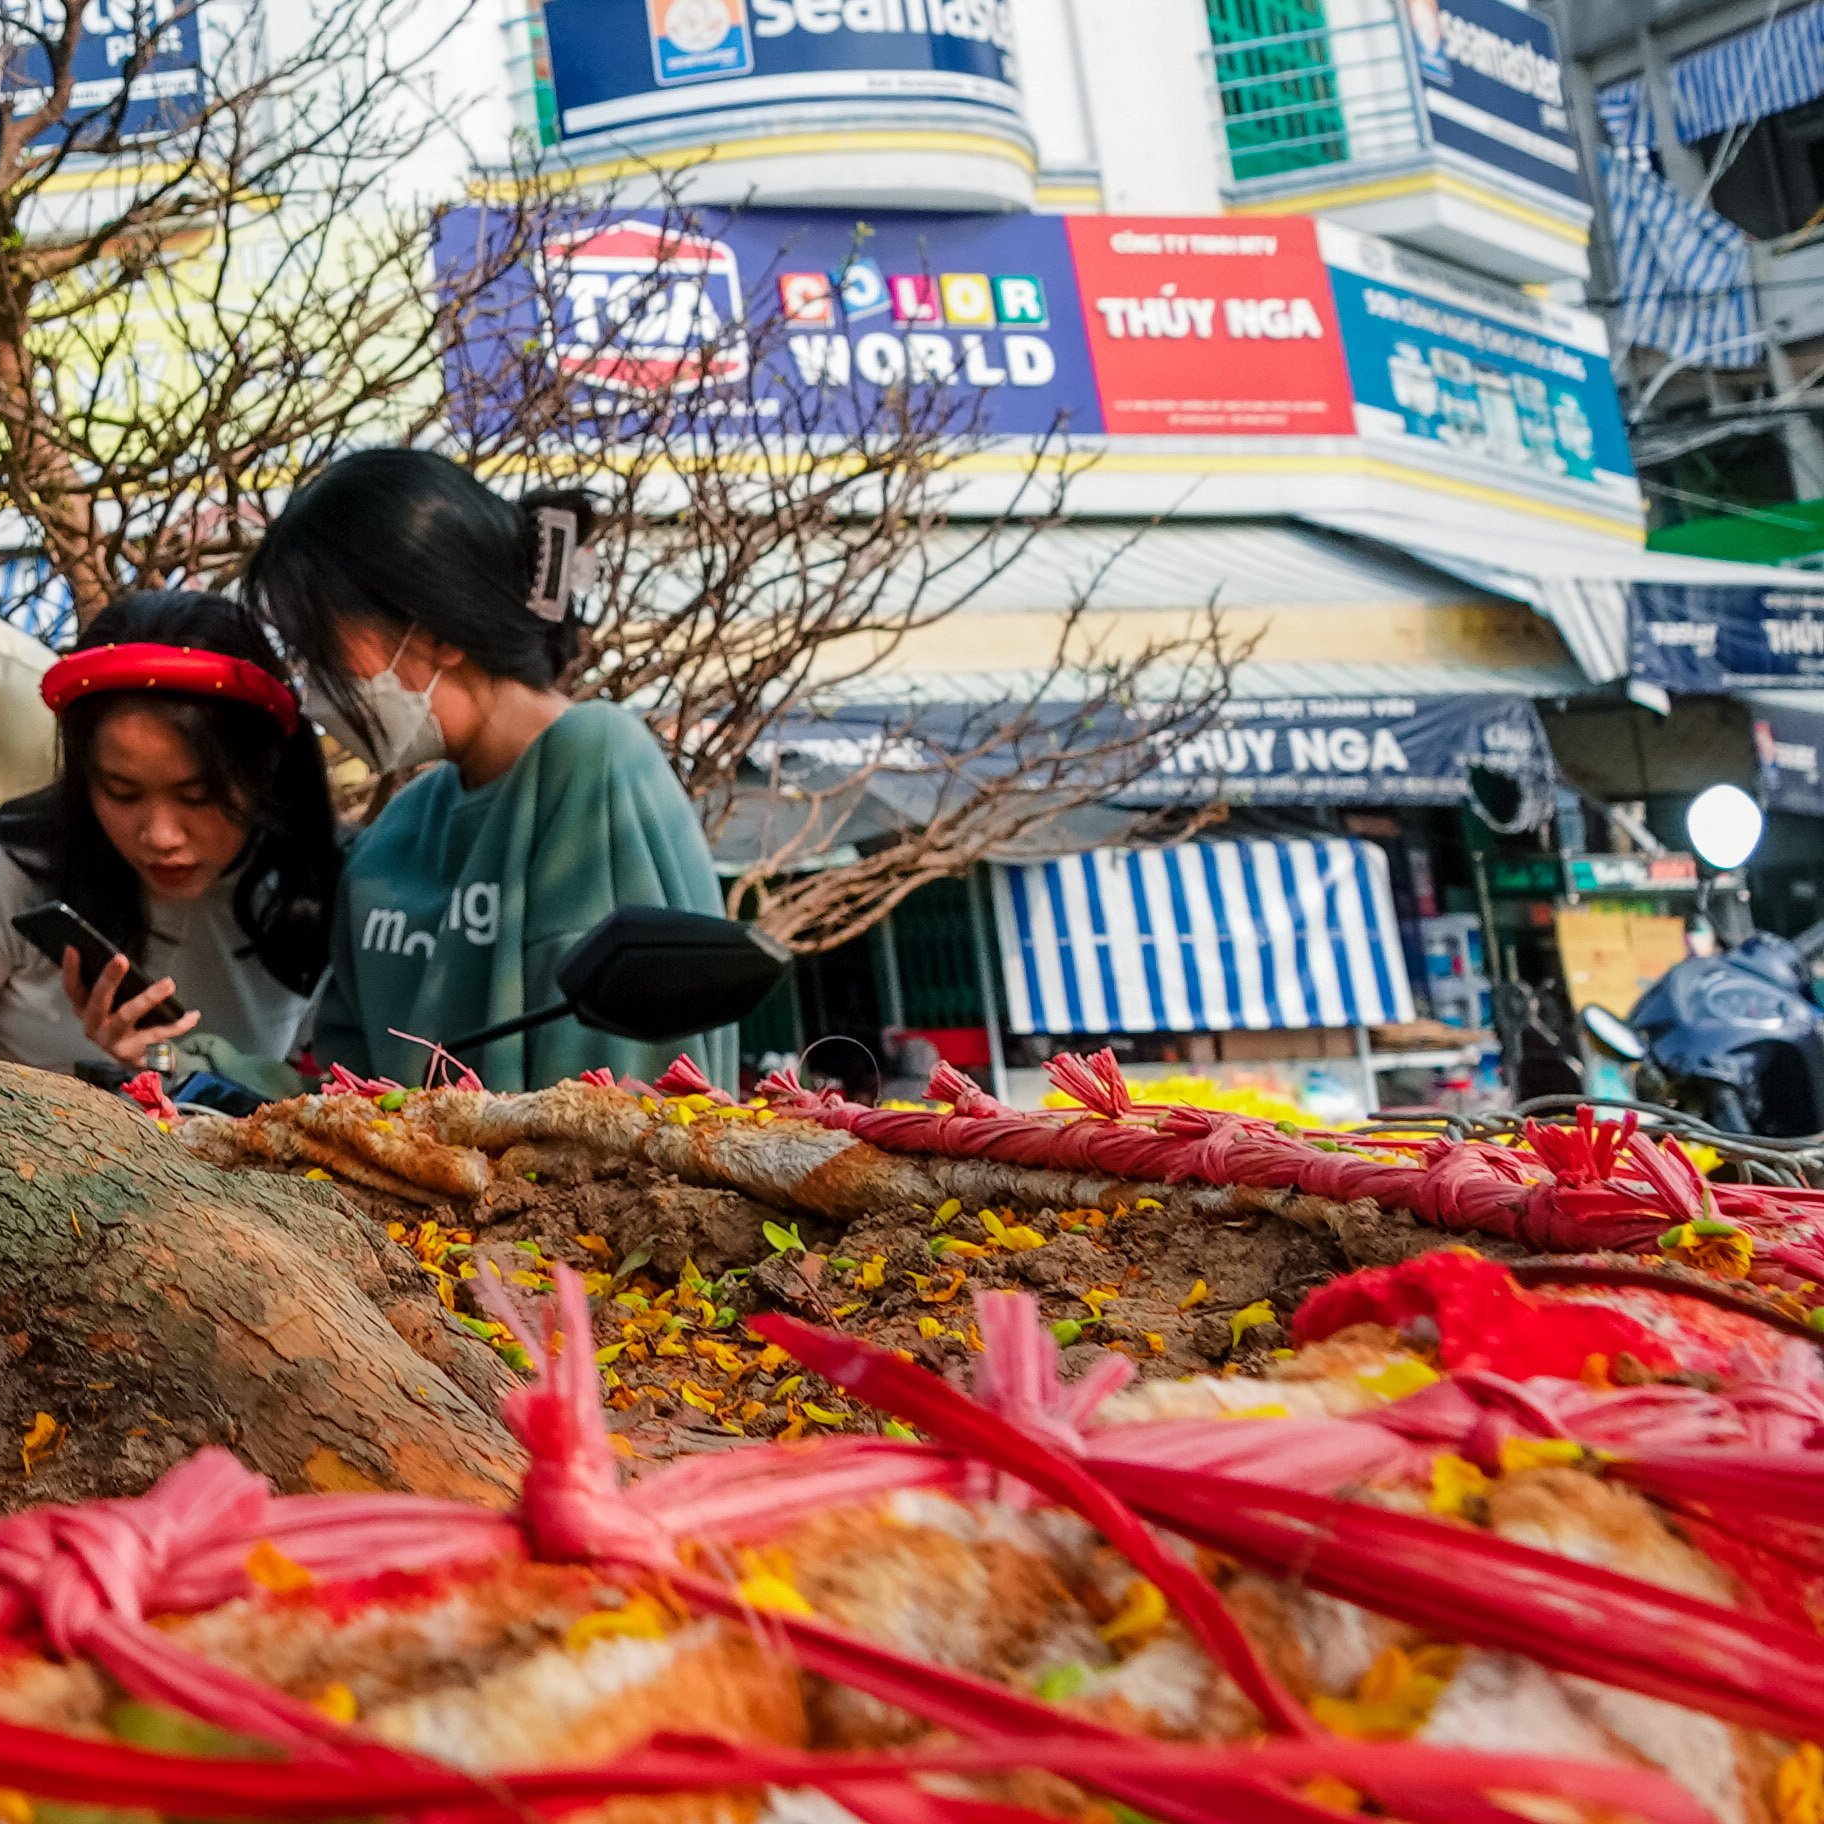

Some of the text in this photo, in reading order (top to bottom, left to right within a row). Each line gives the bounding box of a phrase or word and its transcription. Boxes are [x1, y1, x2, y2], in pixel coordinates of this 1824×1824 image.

[785, 264, 1042, 320] COLOR
[1096, 282, 1325, 340] THÚY NGA
[789, 331, 1056, 387] WORLD
[1288, 727, 1409, 773] NGA
